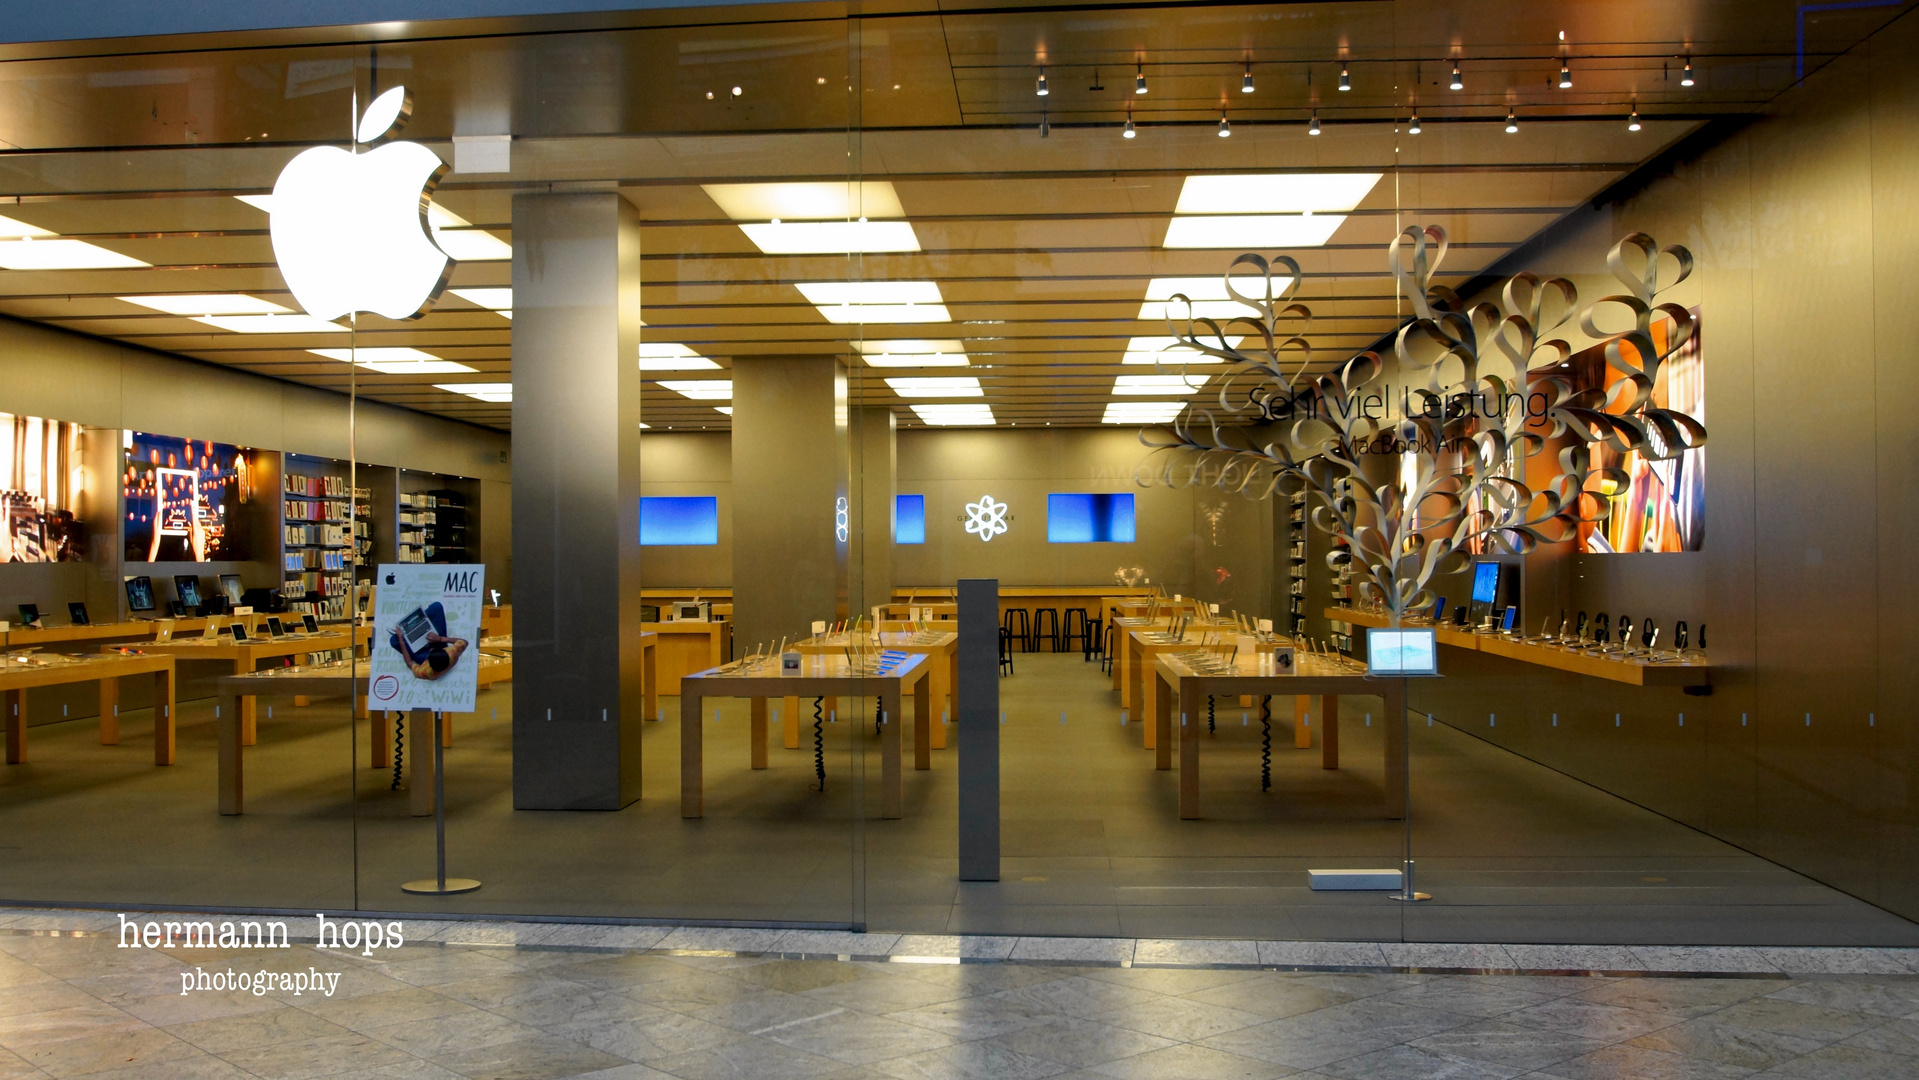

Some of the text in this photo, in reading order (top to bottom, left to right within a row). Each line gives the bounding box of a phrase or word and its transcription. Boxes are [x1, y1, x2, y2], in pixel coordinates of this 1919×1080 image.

[1248, 384, 1557, 428] Sehr viel Leistung.
[1339, 434, 1464, 455] MacBook Air
[443, 571, 479, 593] MAC
